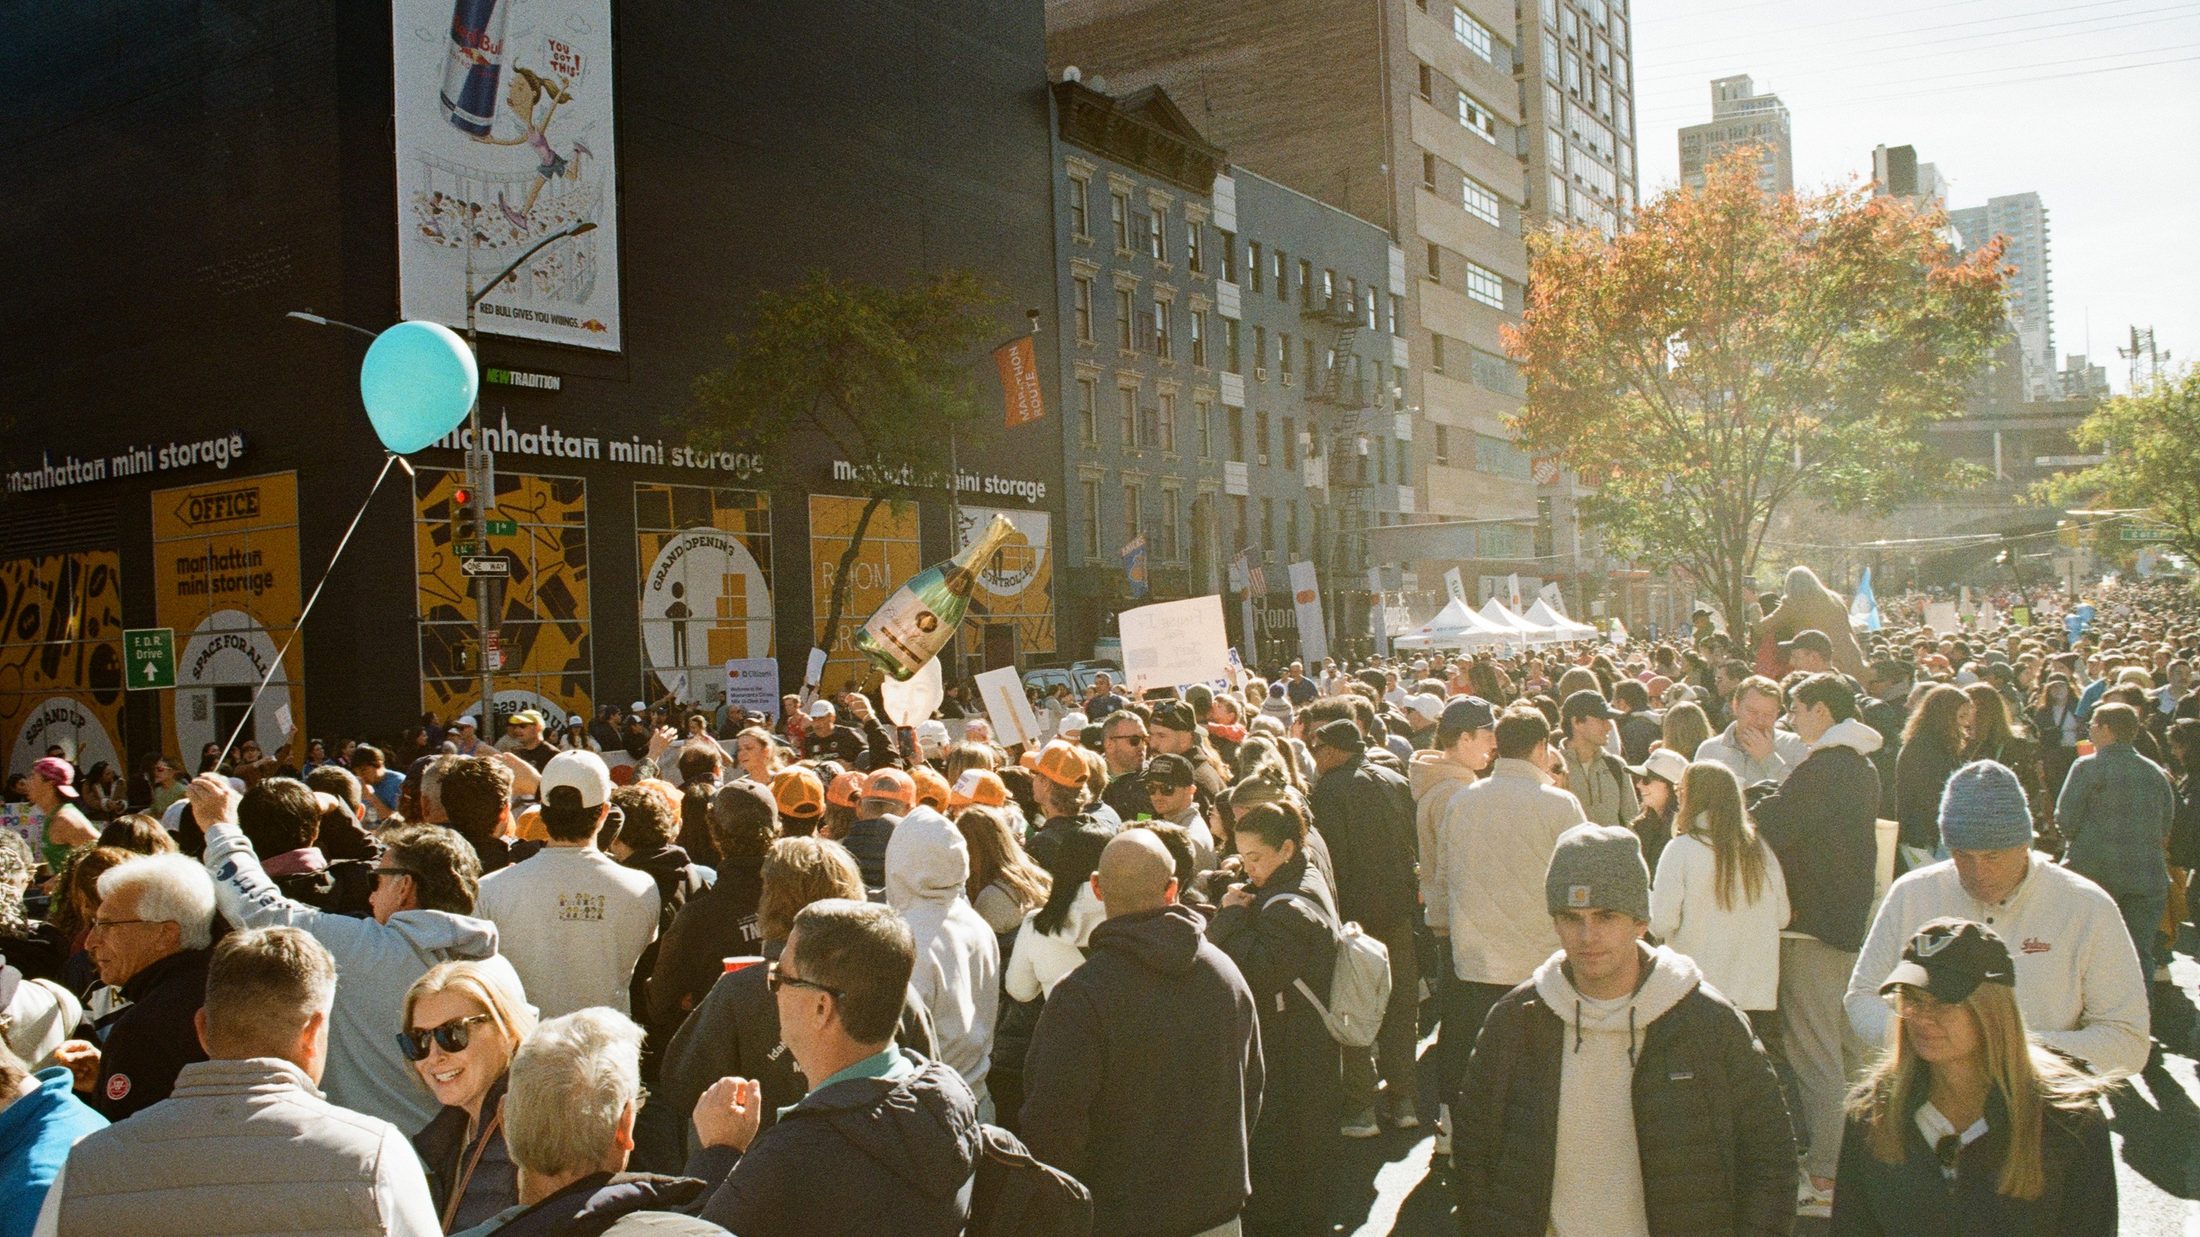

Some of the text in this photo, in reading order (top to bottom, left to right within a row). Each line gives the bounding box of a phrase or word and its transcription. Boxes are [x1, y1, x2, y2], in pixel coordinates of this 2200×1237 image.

[548, 38, 570, 53] YOU
[553, 52, 572, 62] GOT
[480, 302, 495, 315] RED
[495, 304, 512, 318] BULL
[512, 307, 534, 322] GIVES
[534, 311, 550, 324] YOU
[1025, 371, 1043, 417] ROUTE
[6, 433, 244, 493] manhattan mini storage
[610, 435, 664, 465] mini
[671, 445, 765, 481] storage
[985, 474, 1046, 503] storage
[189, 490, 258, 521] OFFICE
[176, 544, 262, 575] manhattan
[467, 562, 505, 571] ONE WAY
[653, 536, 736, 592] GRAND OPENING
[177, 571, 274, 599] mini storage
[822, 562, 891, 590] ROM
[136, 648, 164, 660] Drive
[192, 635, 269, 680] SPACE FOR ALL
[44, 708, 68, 727] AND
[70, 710, 86, 729] UP
